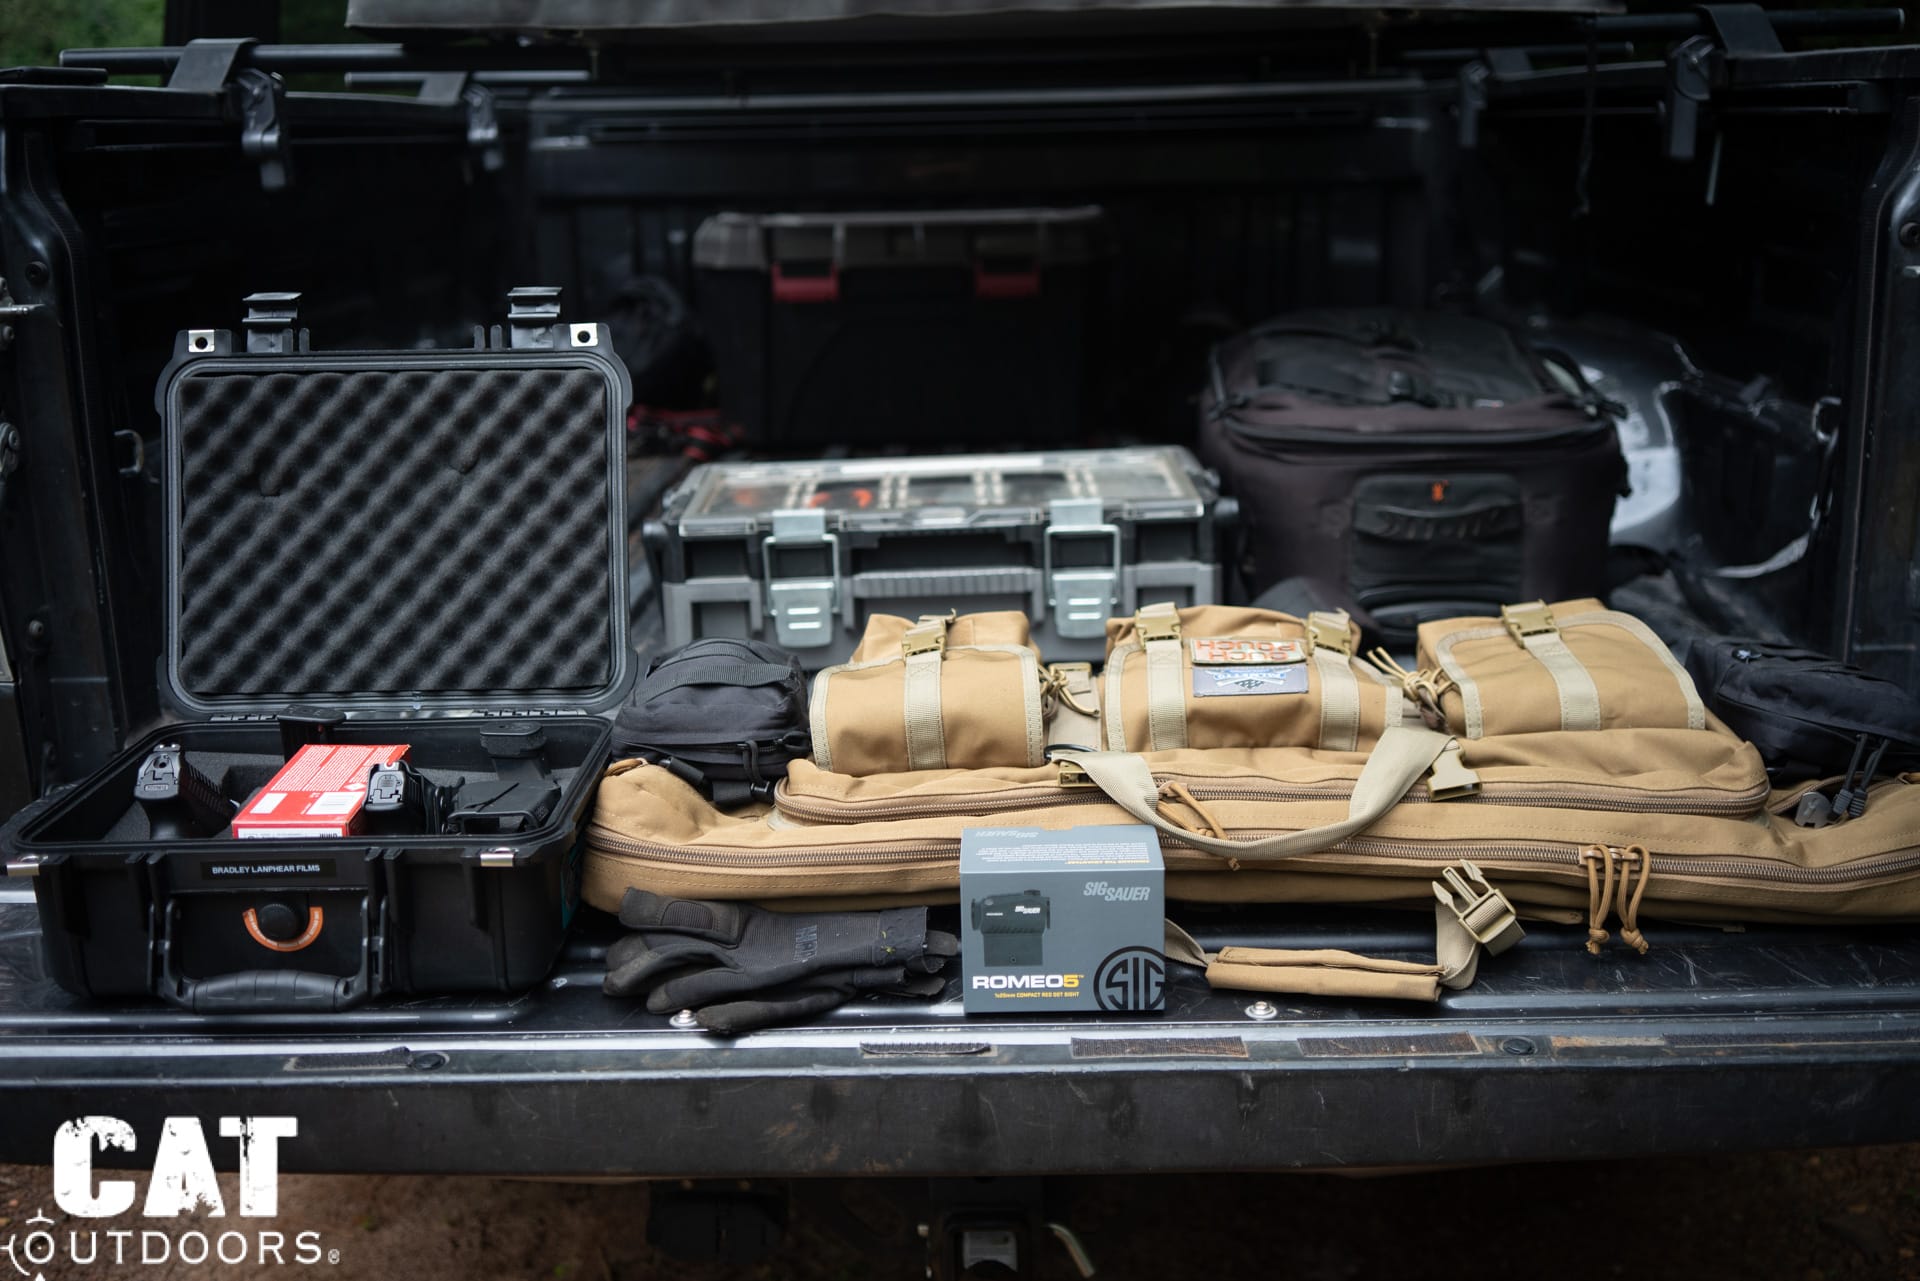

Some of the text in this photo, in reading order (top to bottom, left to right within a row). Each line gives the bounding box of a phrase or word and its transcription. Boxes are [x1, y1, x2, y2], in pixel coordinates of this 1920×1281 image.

[1196, 640, 1295, 651] POUCH
[1209, 651, 1288, 661] OUCH
[211, 864, 321, 875] BRADLEY LANPHEAR FILMS
[1083, 881, 1151, 902] SIG SAUER
